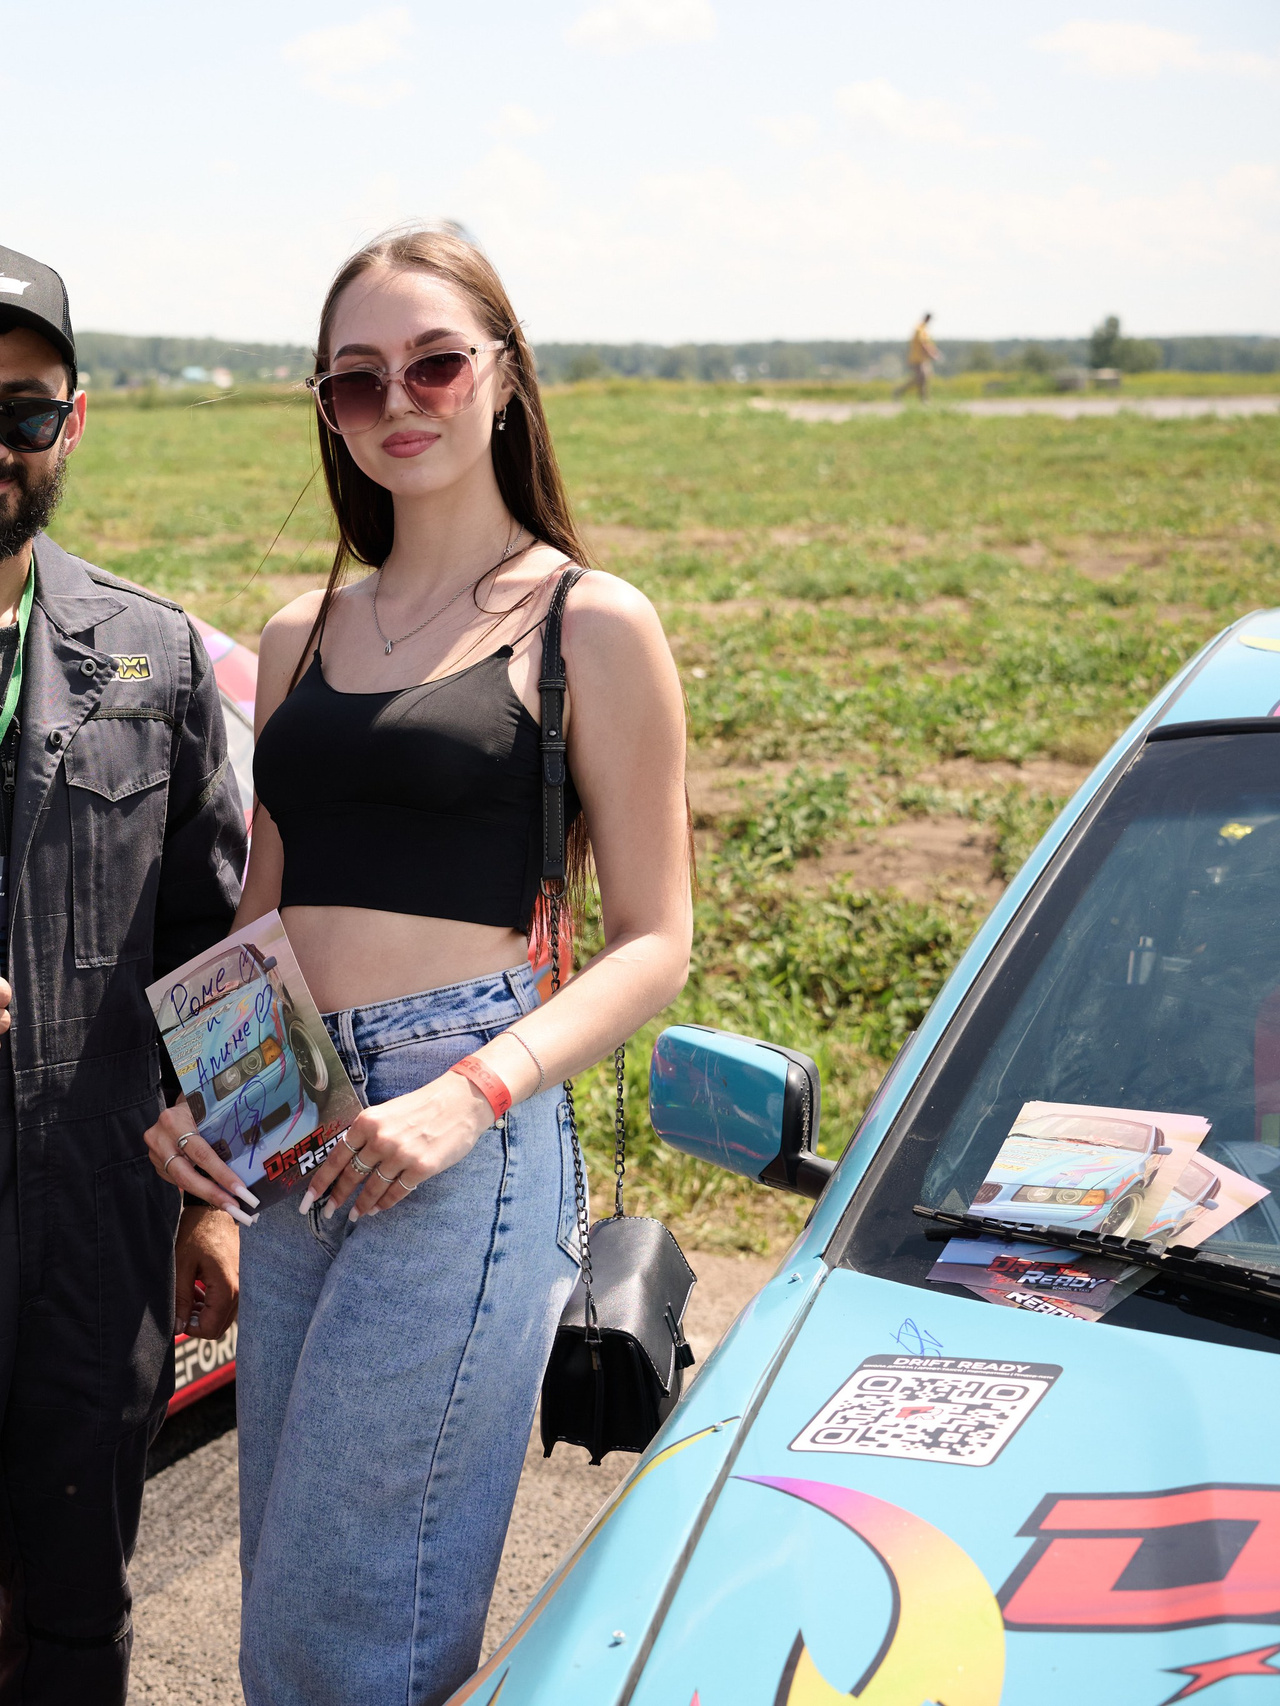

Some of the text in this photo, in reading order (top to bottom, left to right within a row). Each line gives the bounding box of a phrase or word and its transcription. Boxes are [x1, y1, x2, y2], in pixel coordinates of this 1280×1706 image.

[264, 1126, 325, 1181] DRIFT
[1017, 1270, 1108, 1289] READY
[892, 1356, 1031, 1374] DRIFT READY
